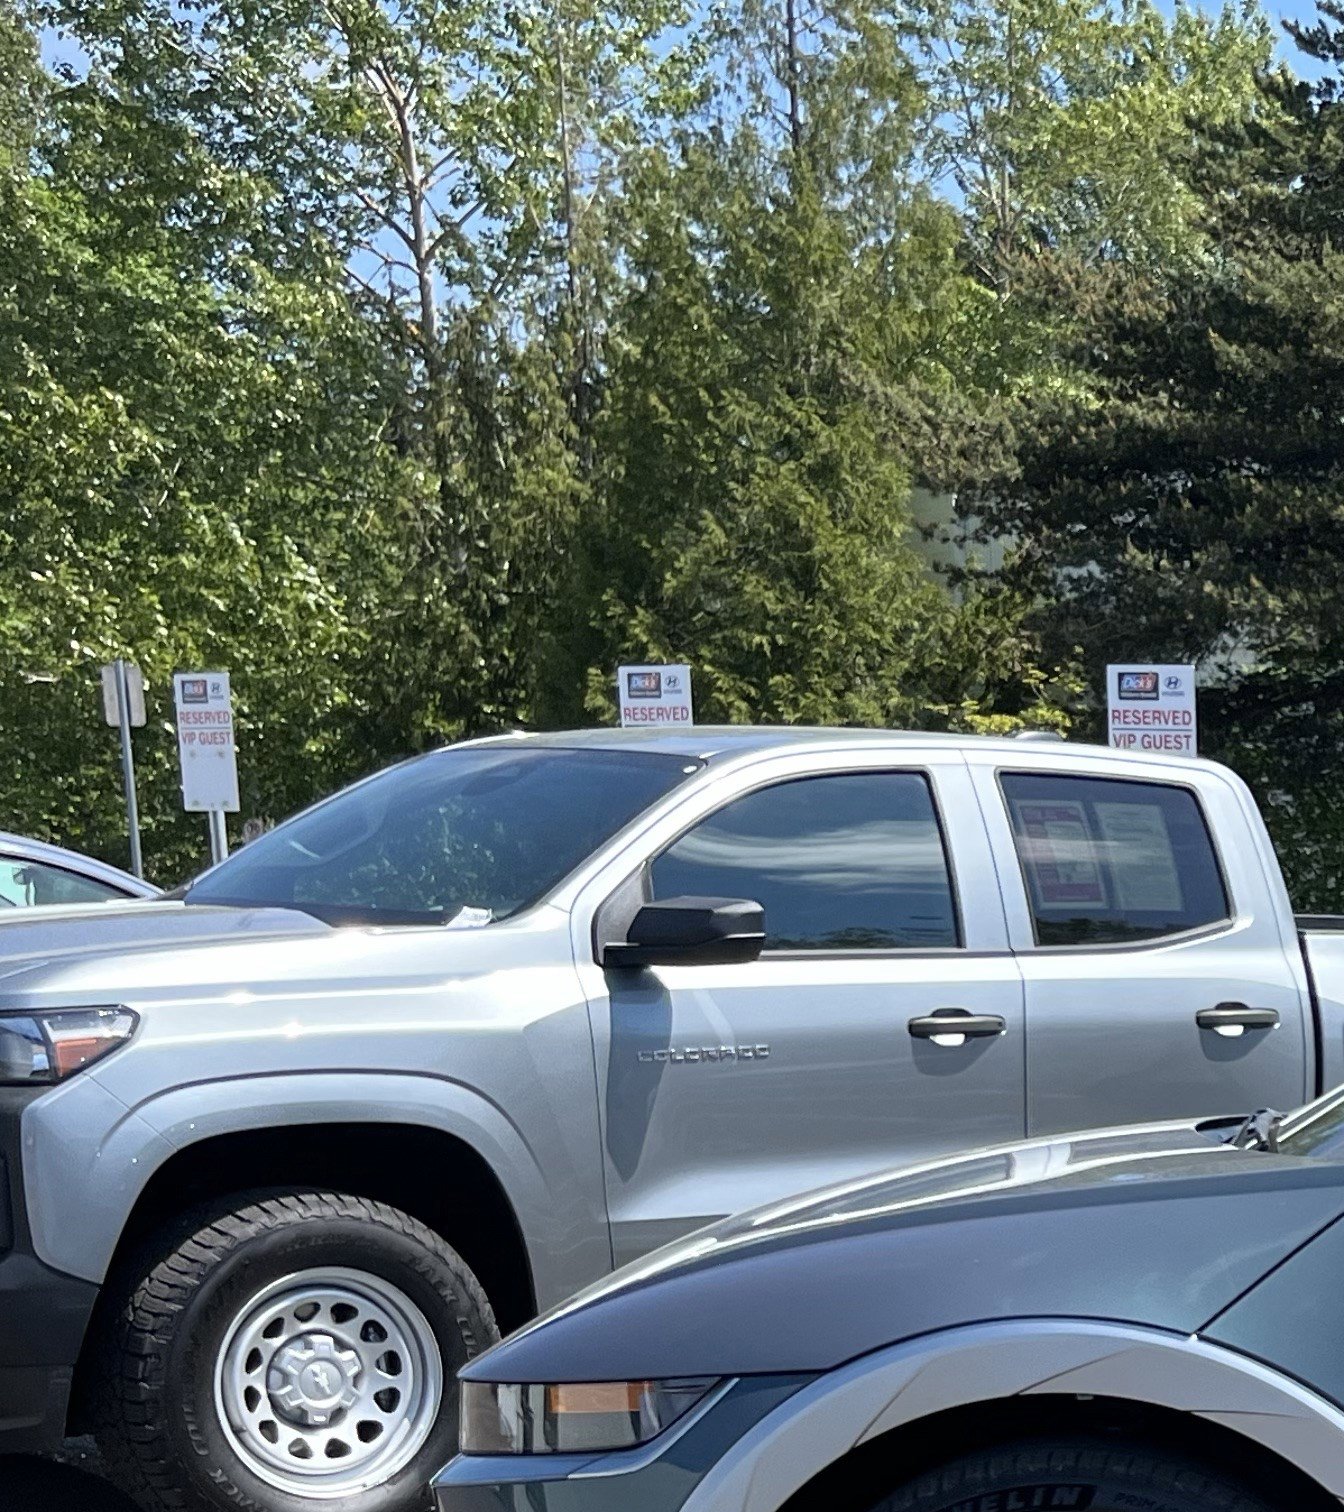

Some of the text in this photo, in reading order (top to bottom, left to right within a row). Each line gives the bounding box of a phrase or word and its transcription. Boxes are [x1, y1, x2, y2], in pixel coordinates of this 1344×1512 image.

[179, 711, 230, 725] RESERVED
[623, 706, 689, 722] RESERVED
[1111, 709, 1192, 726] RESERVED
[181, 732, 231, 745] VIP GUEST
[1113, 733, 1192, 750] VIP GUEST
